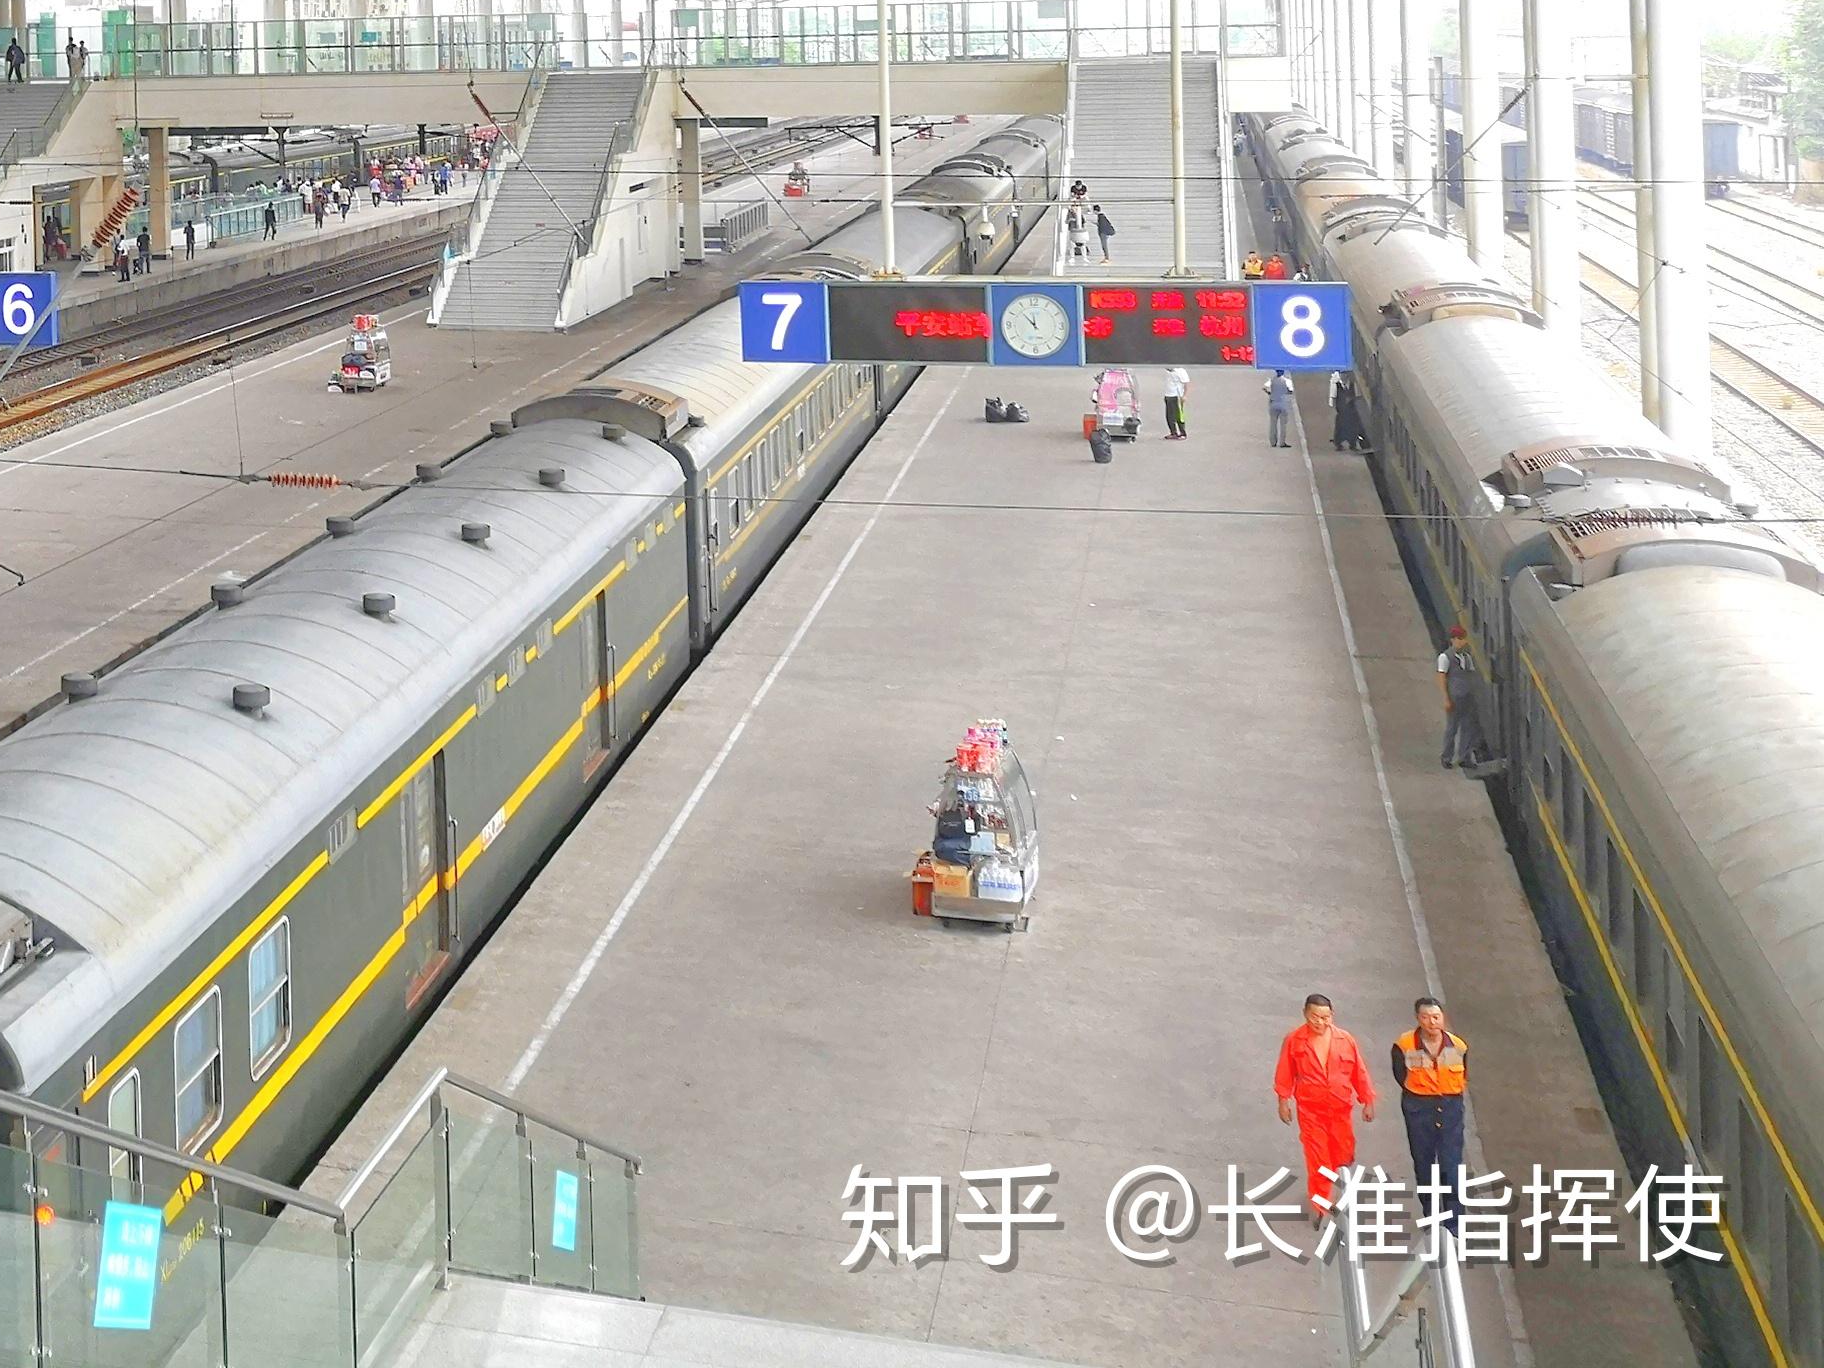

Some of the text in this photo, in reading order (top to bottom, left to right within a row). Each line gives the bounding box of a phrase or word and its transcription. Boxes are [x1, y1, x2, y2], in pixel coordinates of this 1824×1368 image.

[2, 283, 35, 335] 6
[761, 293, 802, 350] 7
[1279, 295, 1325, 357] 8
